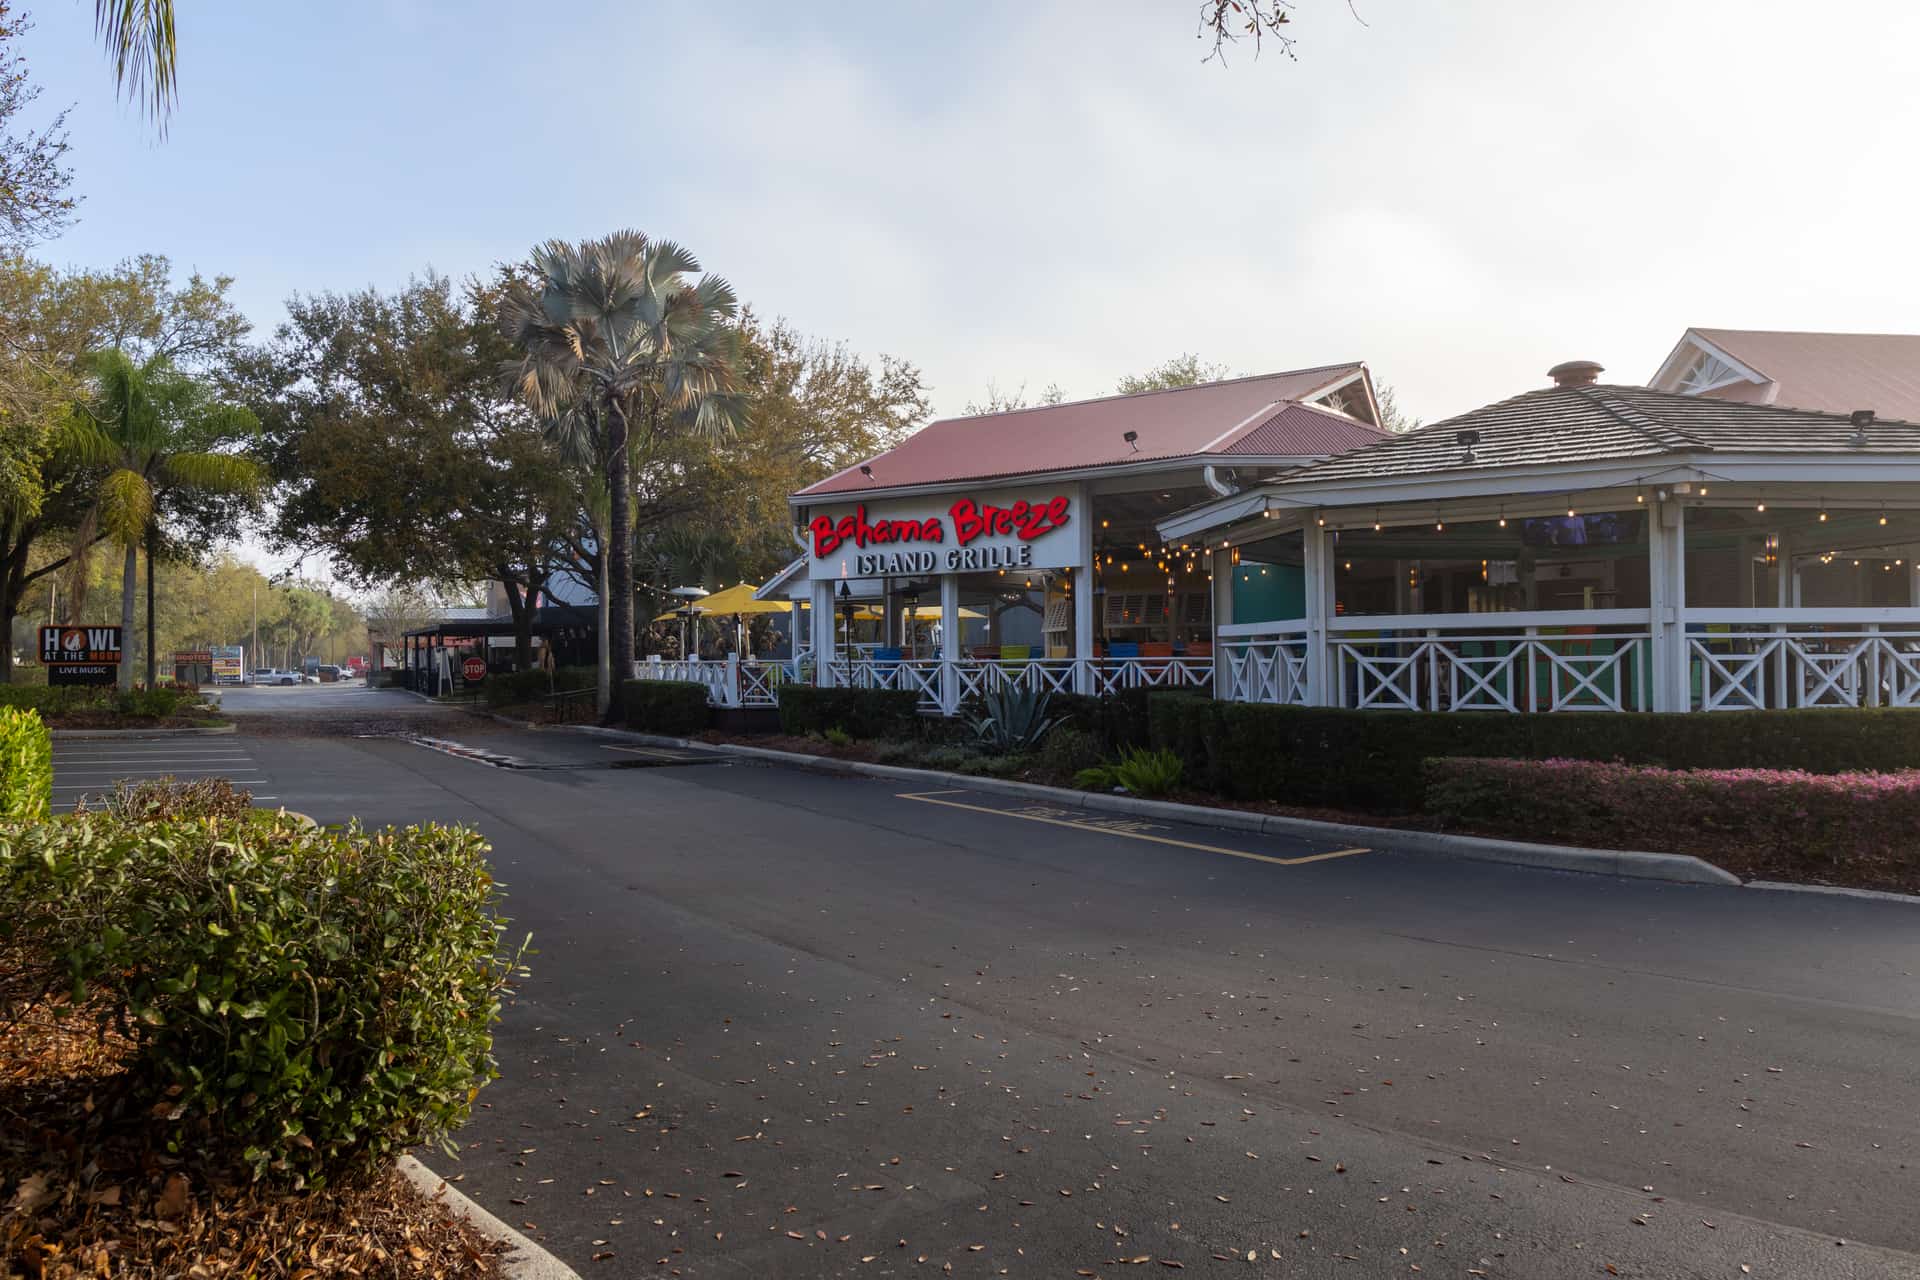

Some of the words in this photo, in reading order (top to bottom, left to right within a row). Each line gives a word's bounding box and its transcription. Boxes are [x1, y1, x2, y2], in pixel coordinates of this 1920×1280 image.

[809, 503, 943, 558] Bahama
[949, 496, 1070, 546] Breeze
[855, 551, 935, 575] ISLAND
[945, 544, 1032, 570] GRILLE
[45, 628, 121, 651] HOWL
[44, 651, 58, 661] AT
[63, 651, 86, 661] THE
[59, 666, 78, 674] LIVE
[79, 666, 107, 674] MUSIC
[464, 664, 485, 674] STOP
